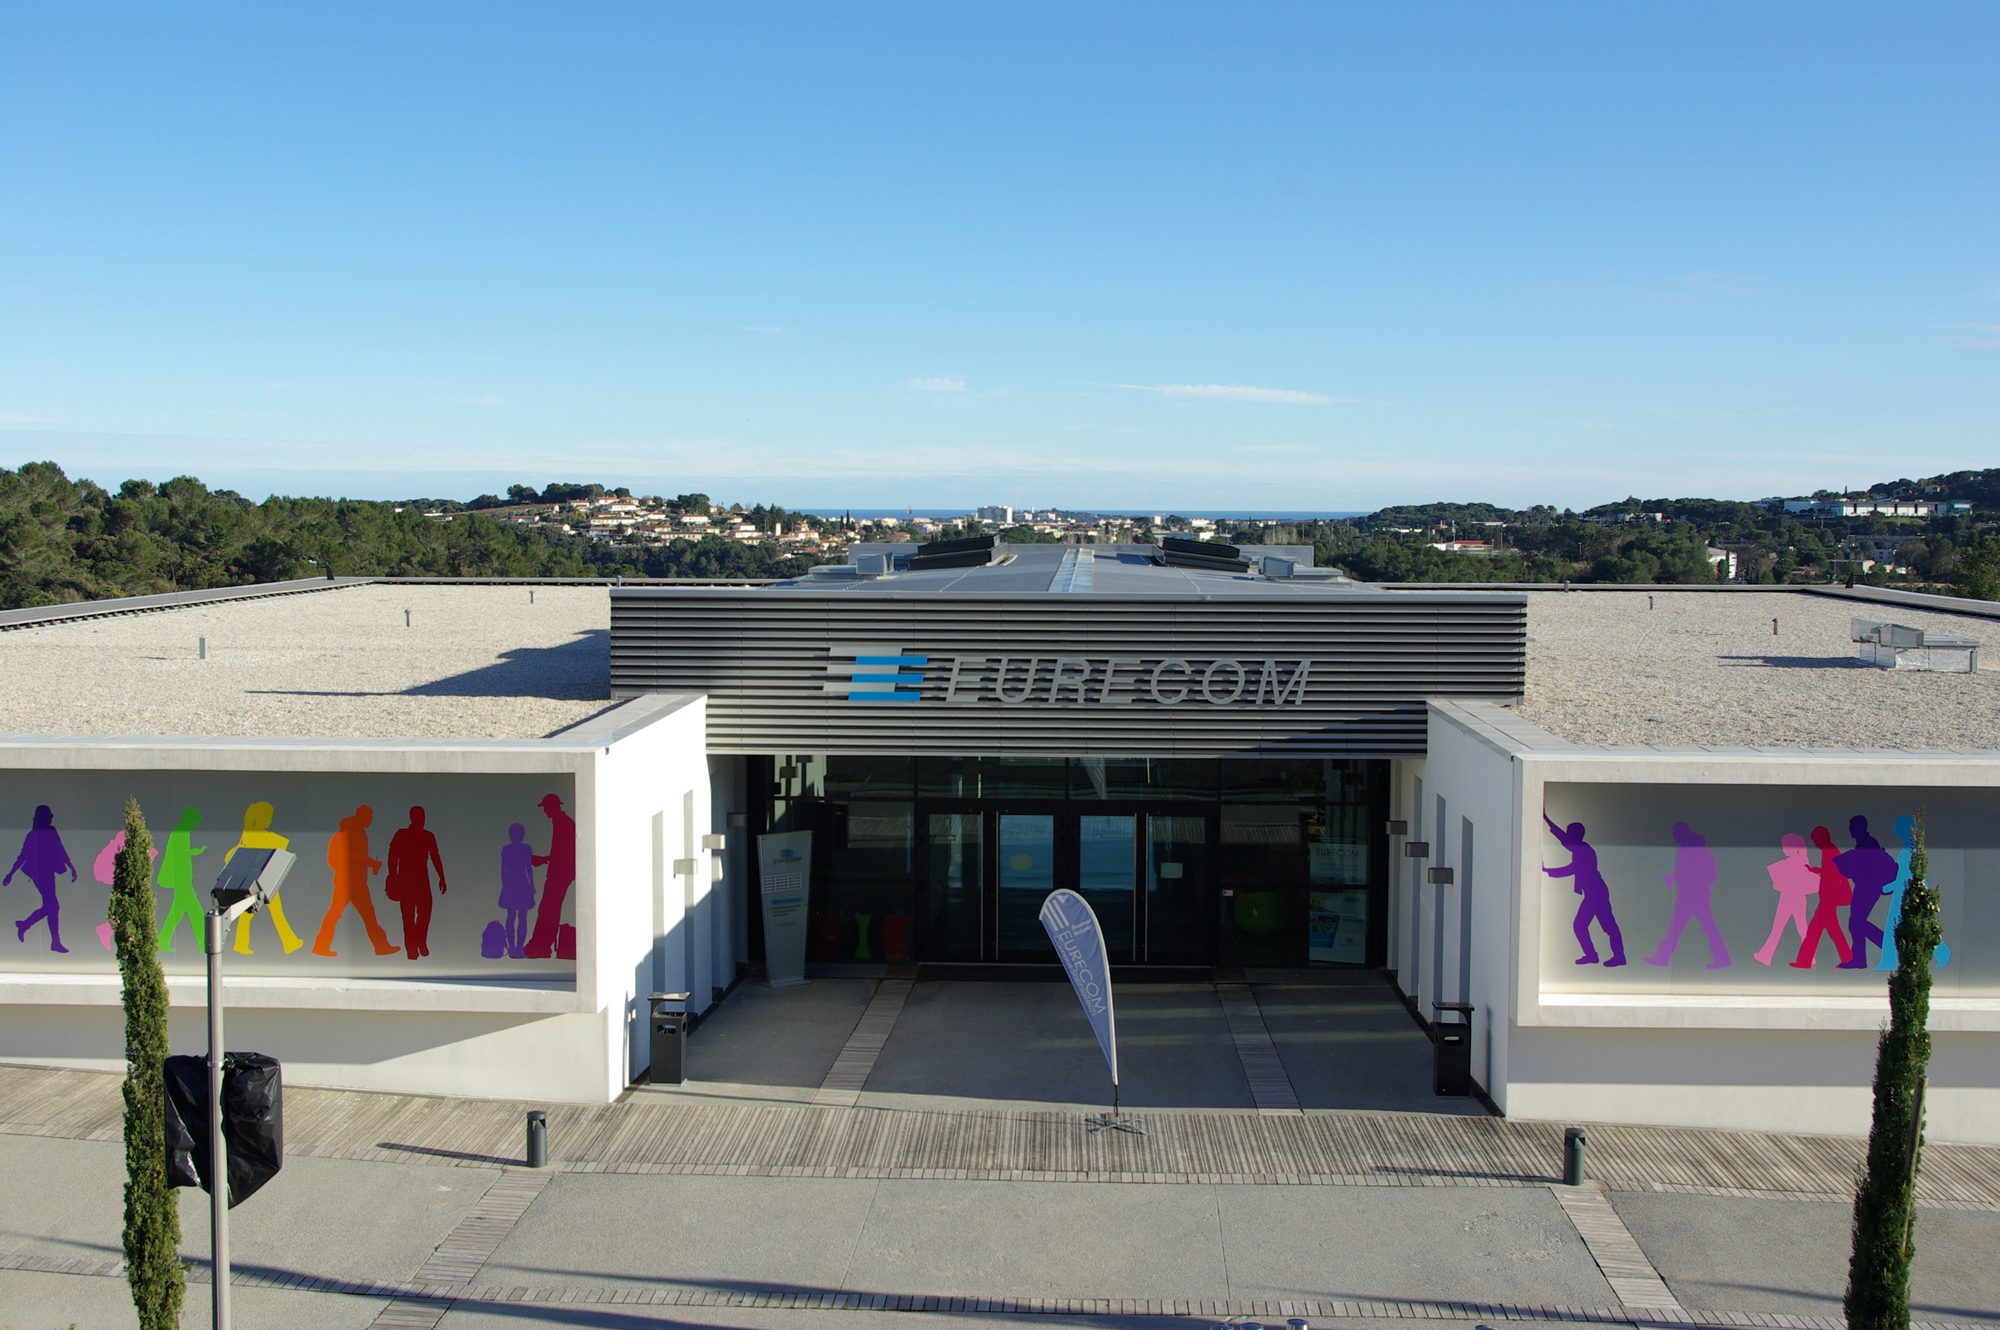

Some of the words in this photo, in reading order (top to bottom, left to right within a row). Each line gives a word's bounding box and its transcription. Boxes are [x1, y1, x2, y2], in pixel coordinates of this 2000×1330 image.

[946, 657, 1311, 706] EURECOM
[1315, 847, 1360, 858] EURECOM
[1053, 935, 1073, 970] Campus
[1059, 930, 1107, 1014] EURECOM
